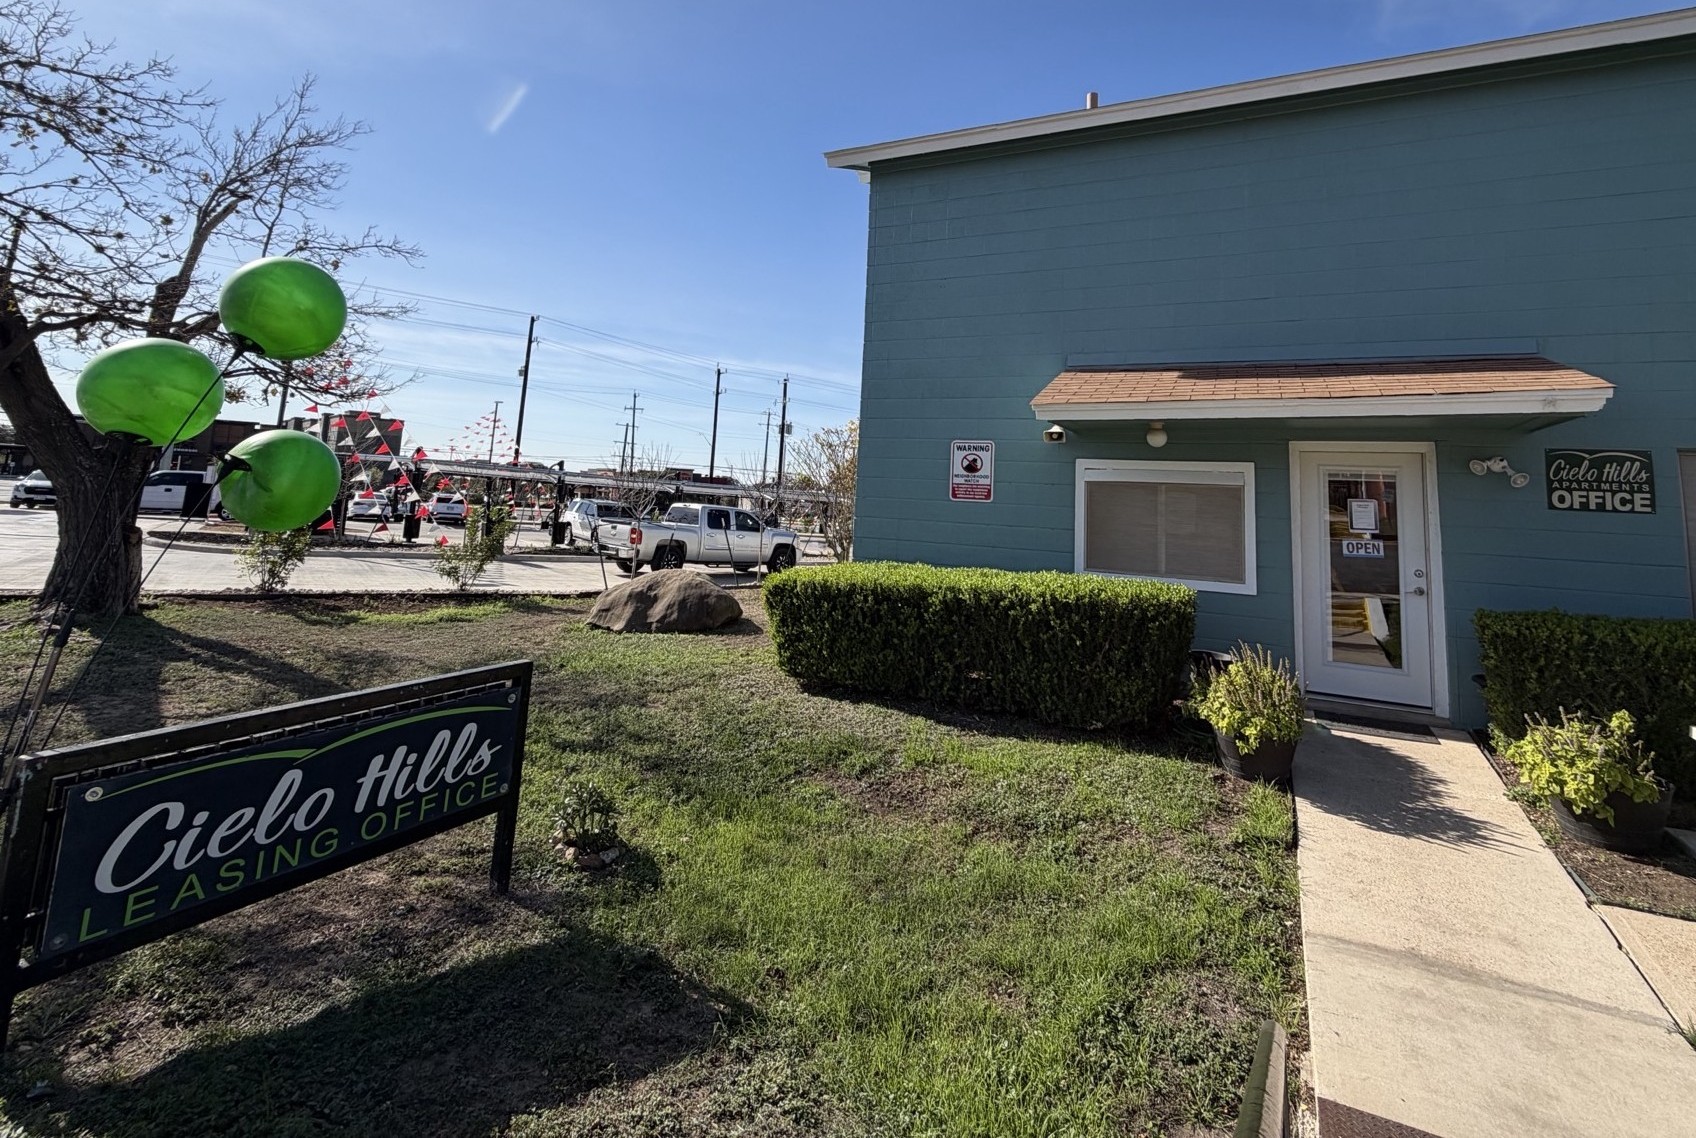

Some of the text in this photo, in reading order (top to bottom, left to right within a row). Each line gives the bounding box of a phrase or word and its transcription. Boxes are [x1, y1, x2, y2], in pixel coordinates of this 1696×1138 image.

[1549, 459, 1650, 483] Cielo Hills
[1551, 481, 1650, 492] APARTMENTS
[1551, 489, 1652, 512] OFFICE
[1346, 542, 1381, 555] OPEN
[94, 722, 503, 894] Cielo Hills
[79, 772, 499, 943] LEASING OFFICE
